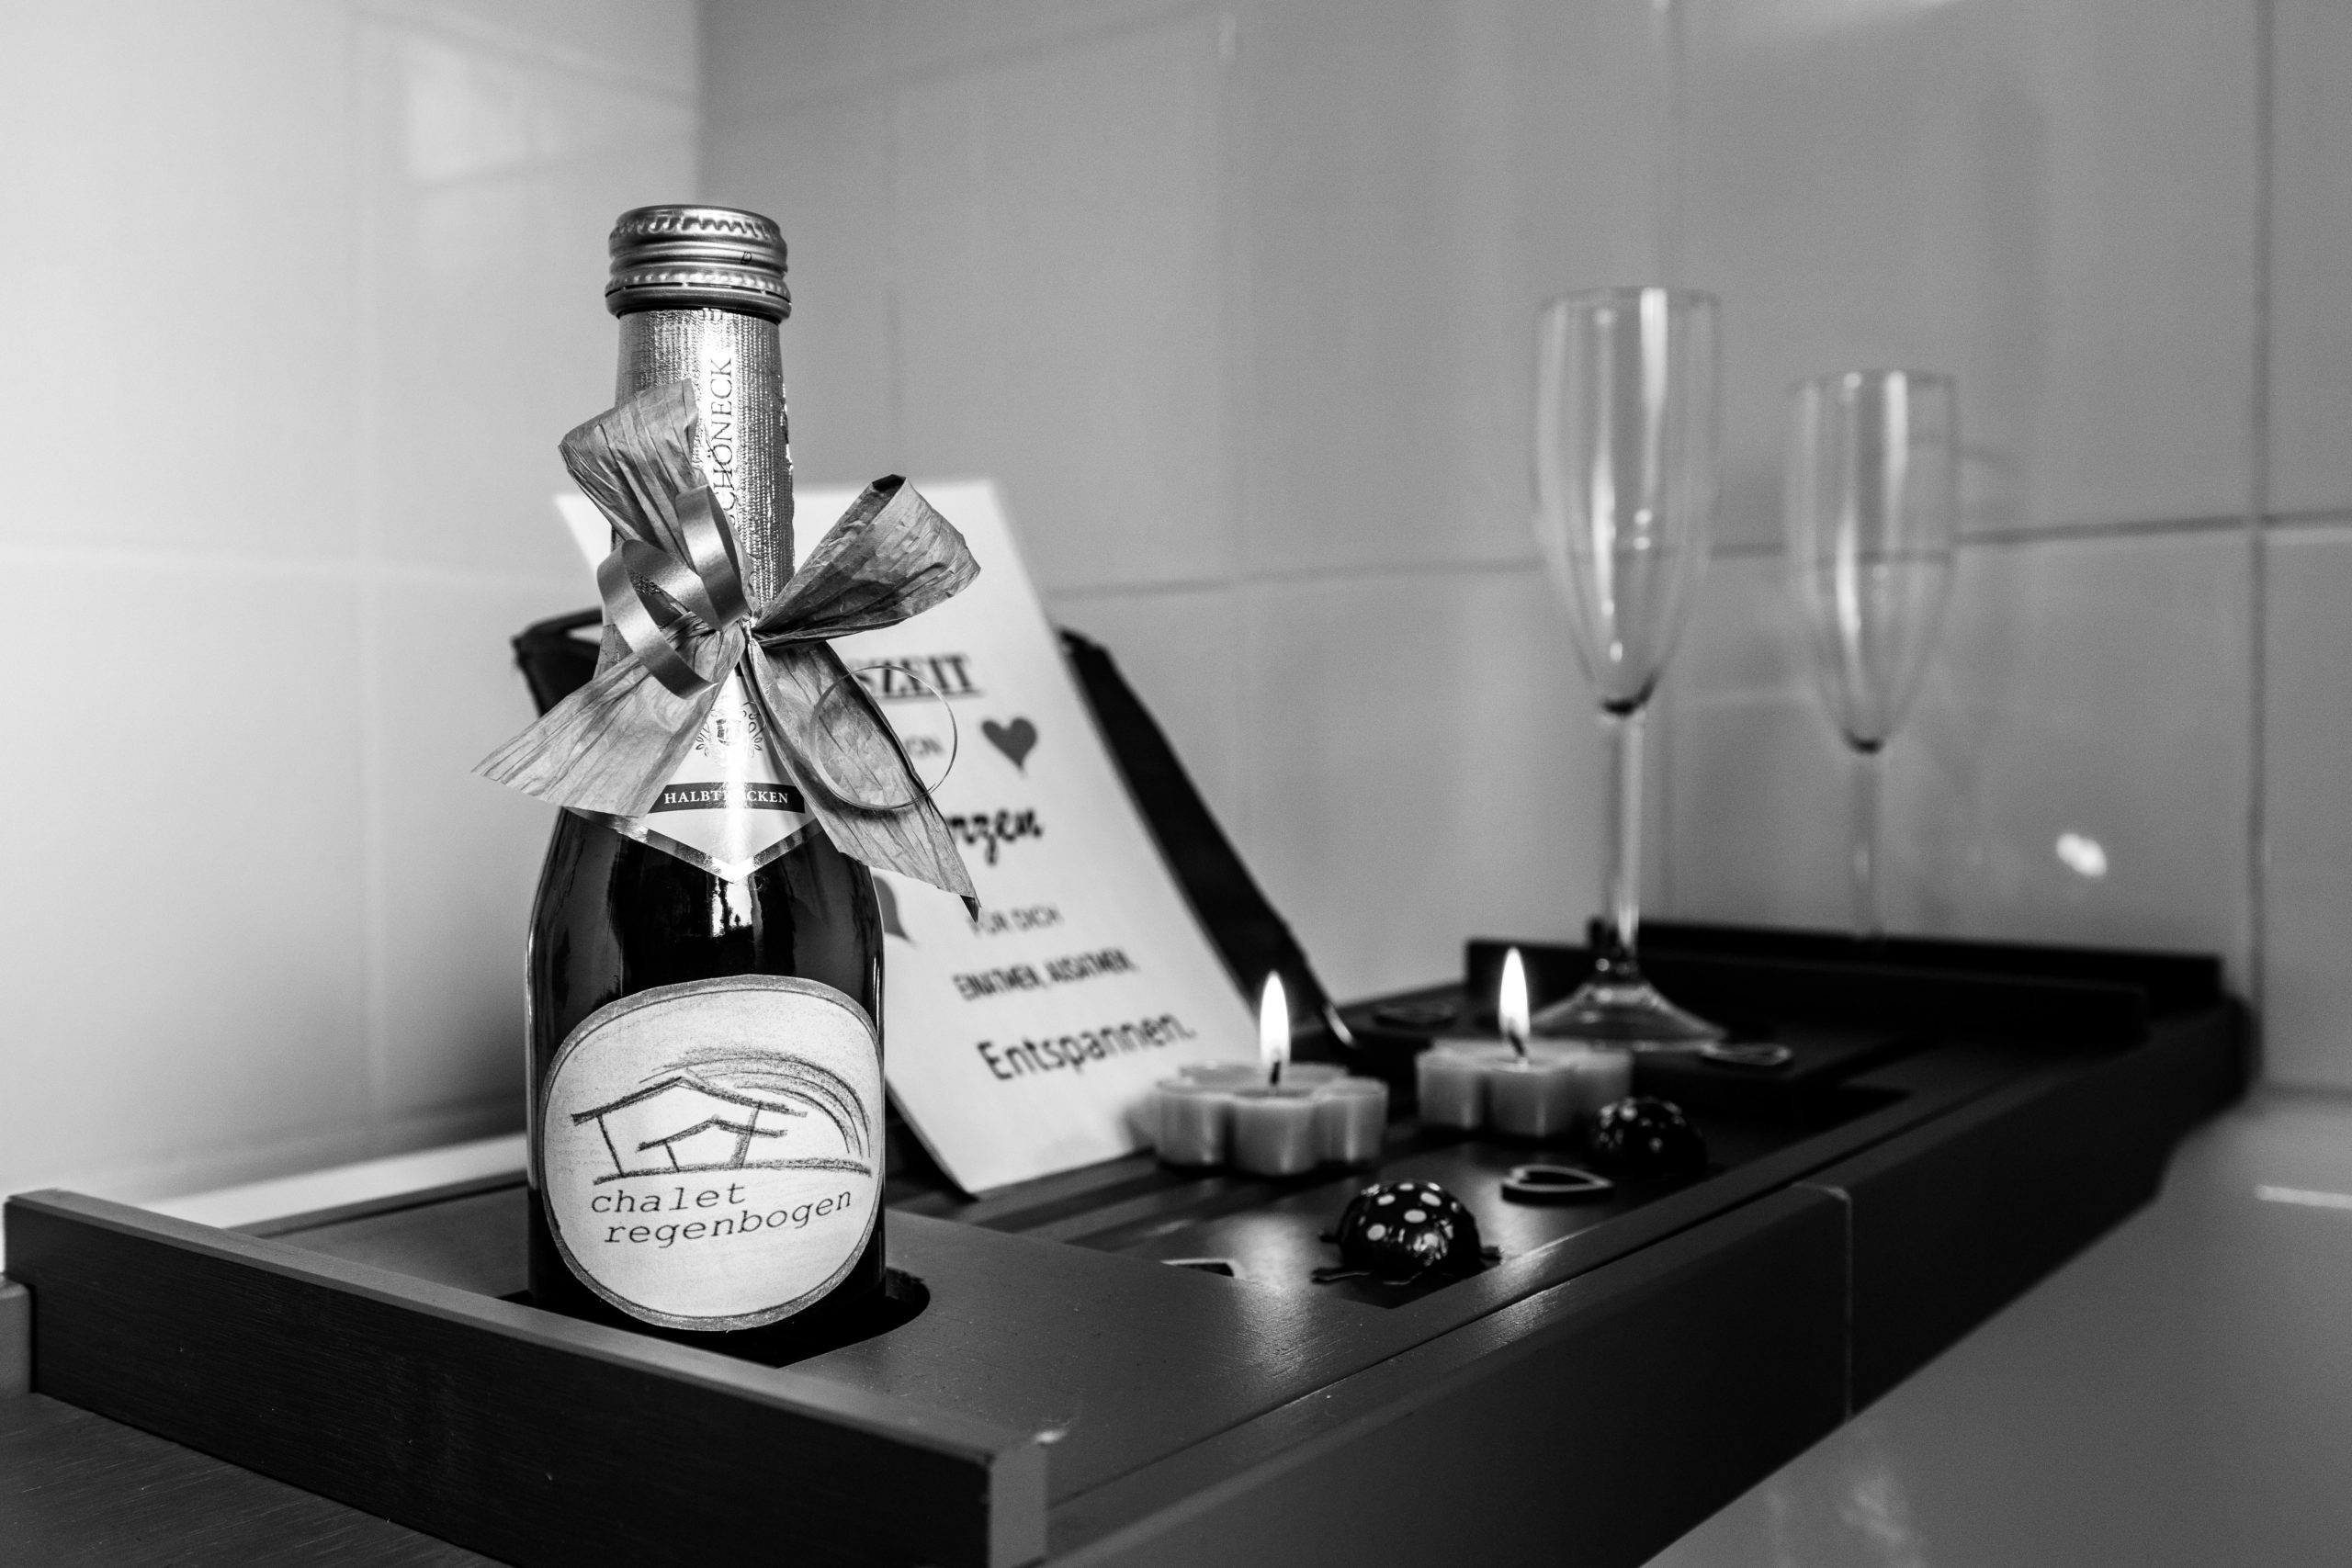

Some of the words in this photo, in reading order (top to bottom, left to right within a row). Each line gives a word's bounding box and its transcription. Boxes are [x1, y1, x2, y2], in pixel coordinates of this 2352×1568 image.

[706, 357, 736, 526] CHÖNECK
[663, 789, 789, 805] HALBTCKEN
[946, 807, 1044, 867] rzen
[591, 1182, 745, 1213] chalet
[604, 1190, 852, 1249] regenbogen
